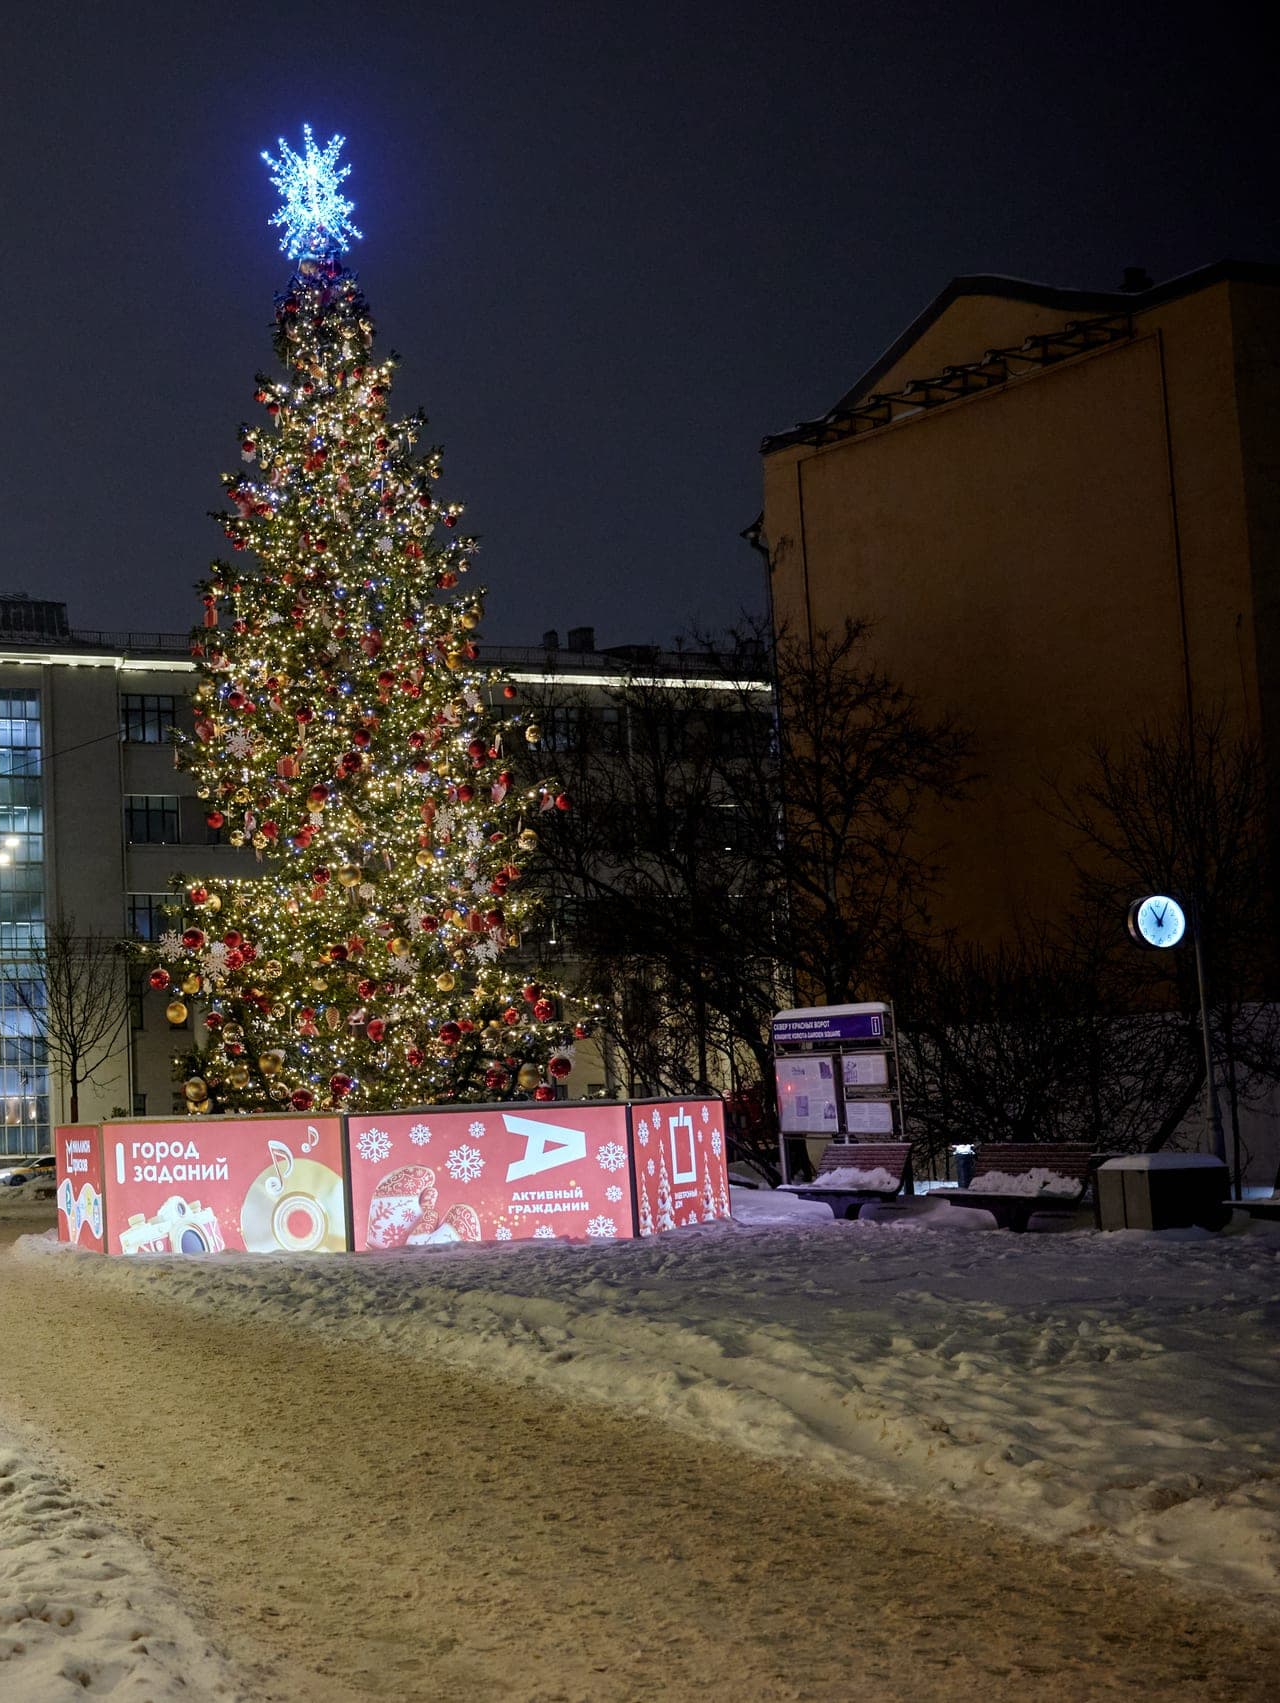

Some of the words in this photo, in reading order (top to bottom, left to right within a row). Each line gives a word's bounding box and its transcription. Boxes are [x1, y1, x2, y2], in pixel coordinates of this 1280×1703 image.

[132, 1140, 200, 1164] город
[133, 1157, 229, 1184] заданий
[512, 1186, 584, 1201] АКТИВНЫЙ
[507, 1201, 590, 1215] ГРАЖДАНИН
